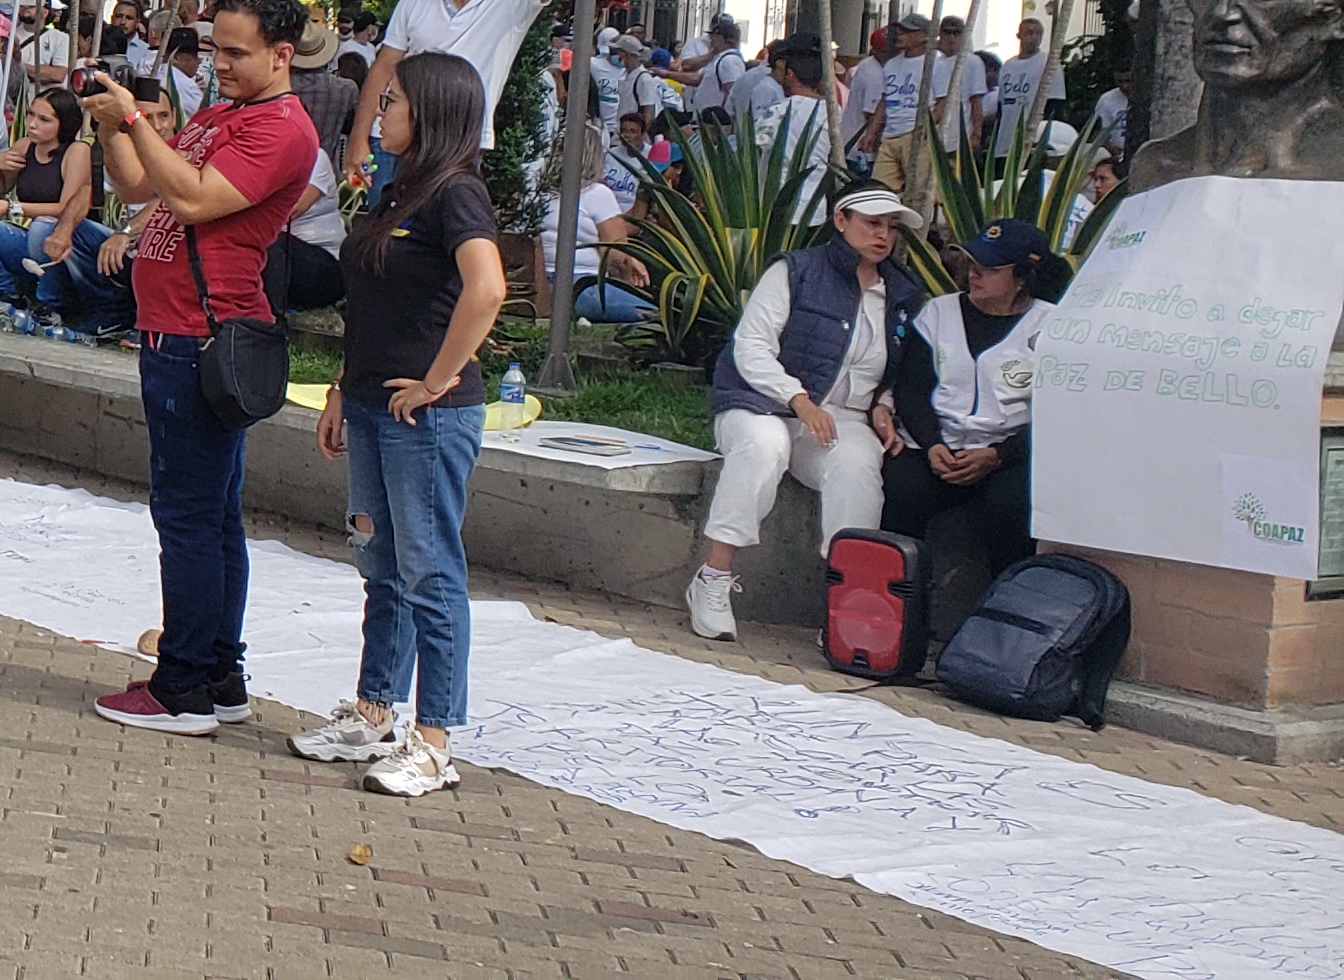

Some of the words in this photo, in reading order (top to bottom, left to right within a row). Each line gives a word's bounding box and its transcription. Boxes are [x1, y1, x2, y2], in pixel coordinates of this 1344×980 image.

[1104, 281, 1198, 321] Invito
[1206, 303, 1225, 323] a
[1249, 341, 1270, 362] a
[1103, 370, 1147, 392] DE
[1253, 520, 1305, 544] COAPAZ
